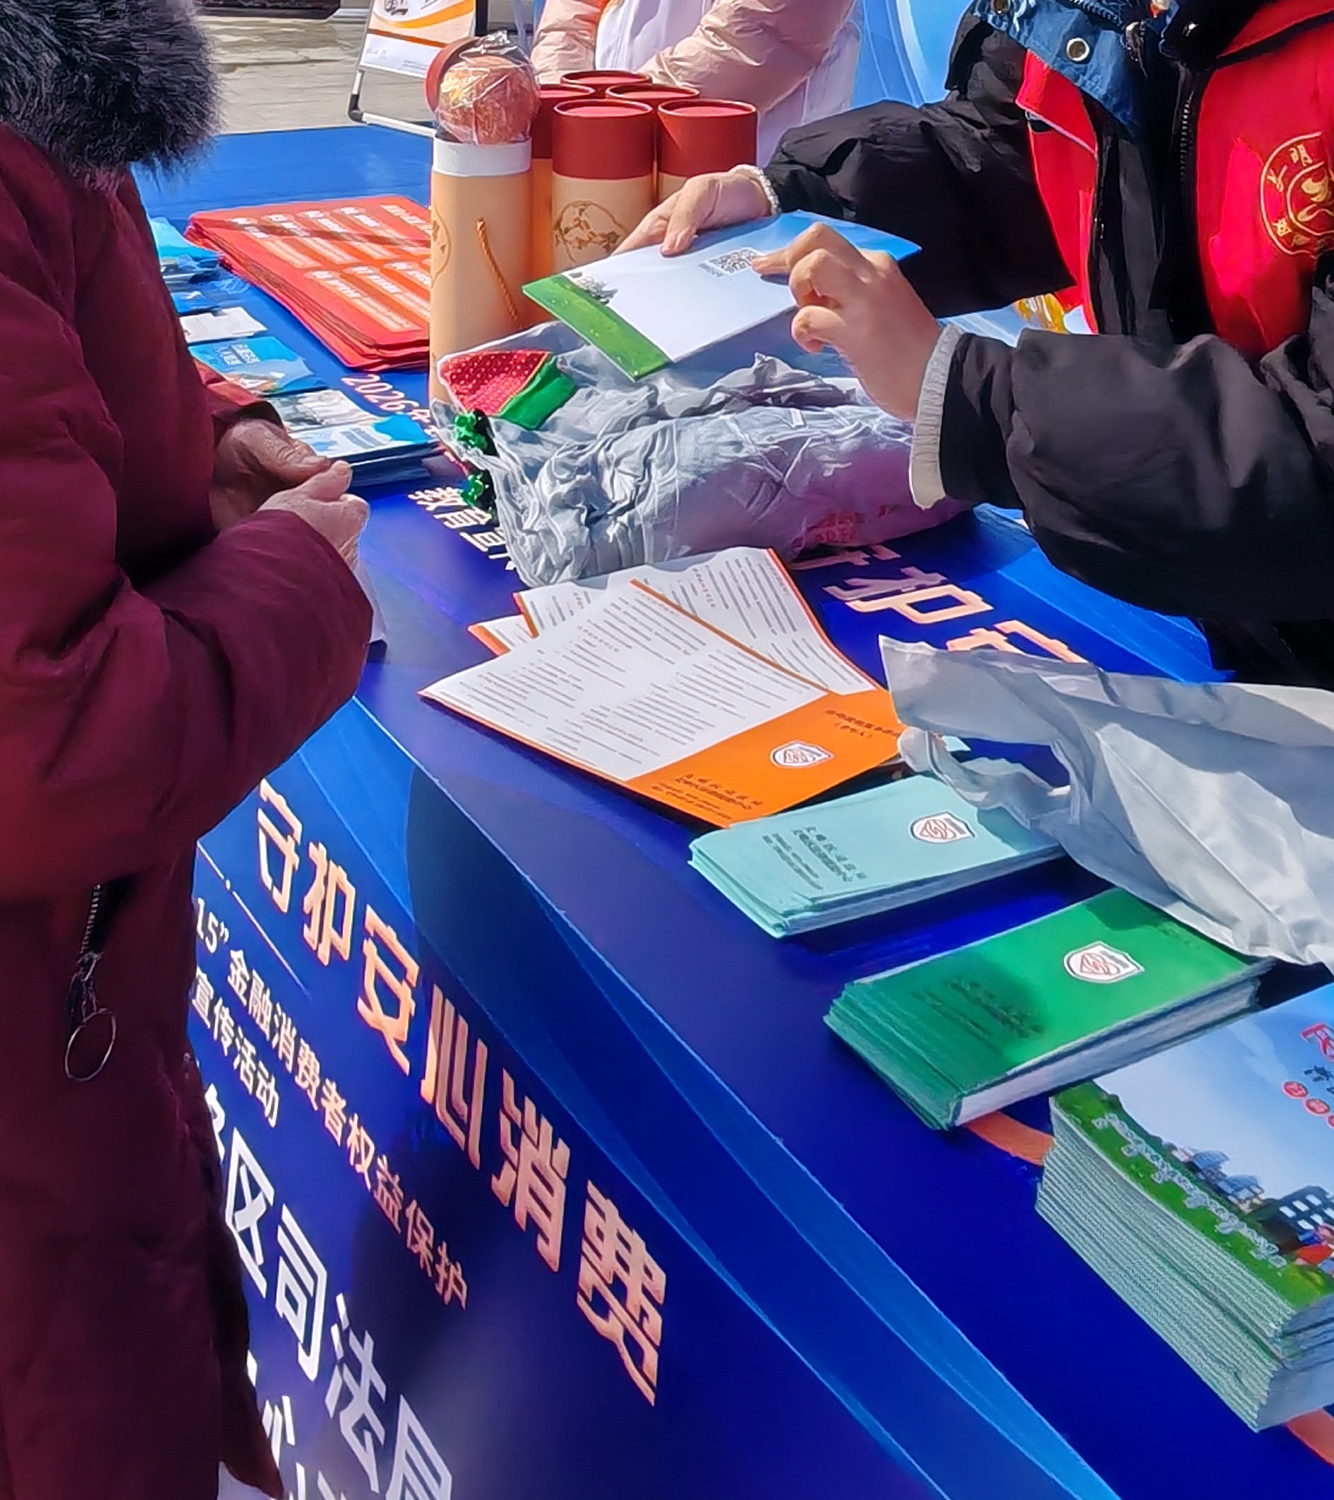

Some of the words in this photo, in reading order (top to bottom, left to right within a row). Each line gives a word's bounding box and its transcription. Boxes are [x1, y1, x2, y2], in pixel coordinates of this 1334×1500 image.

[257, 778, 667, 1407] 守护安心消费
